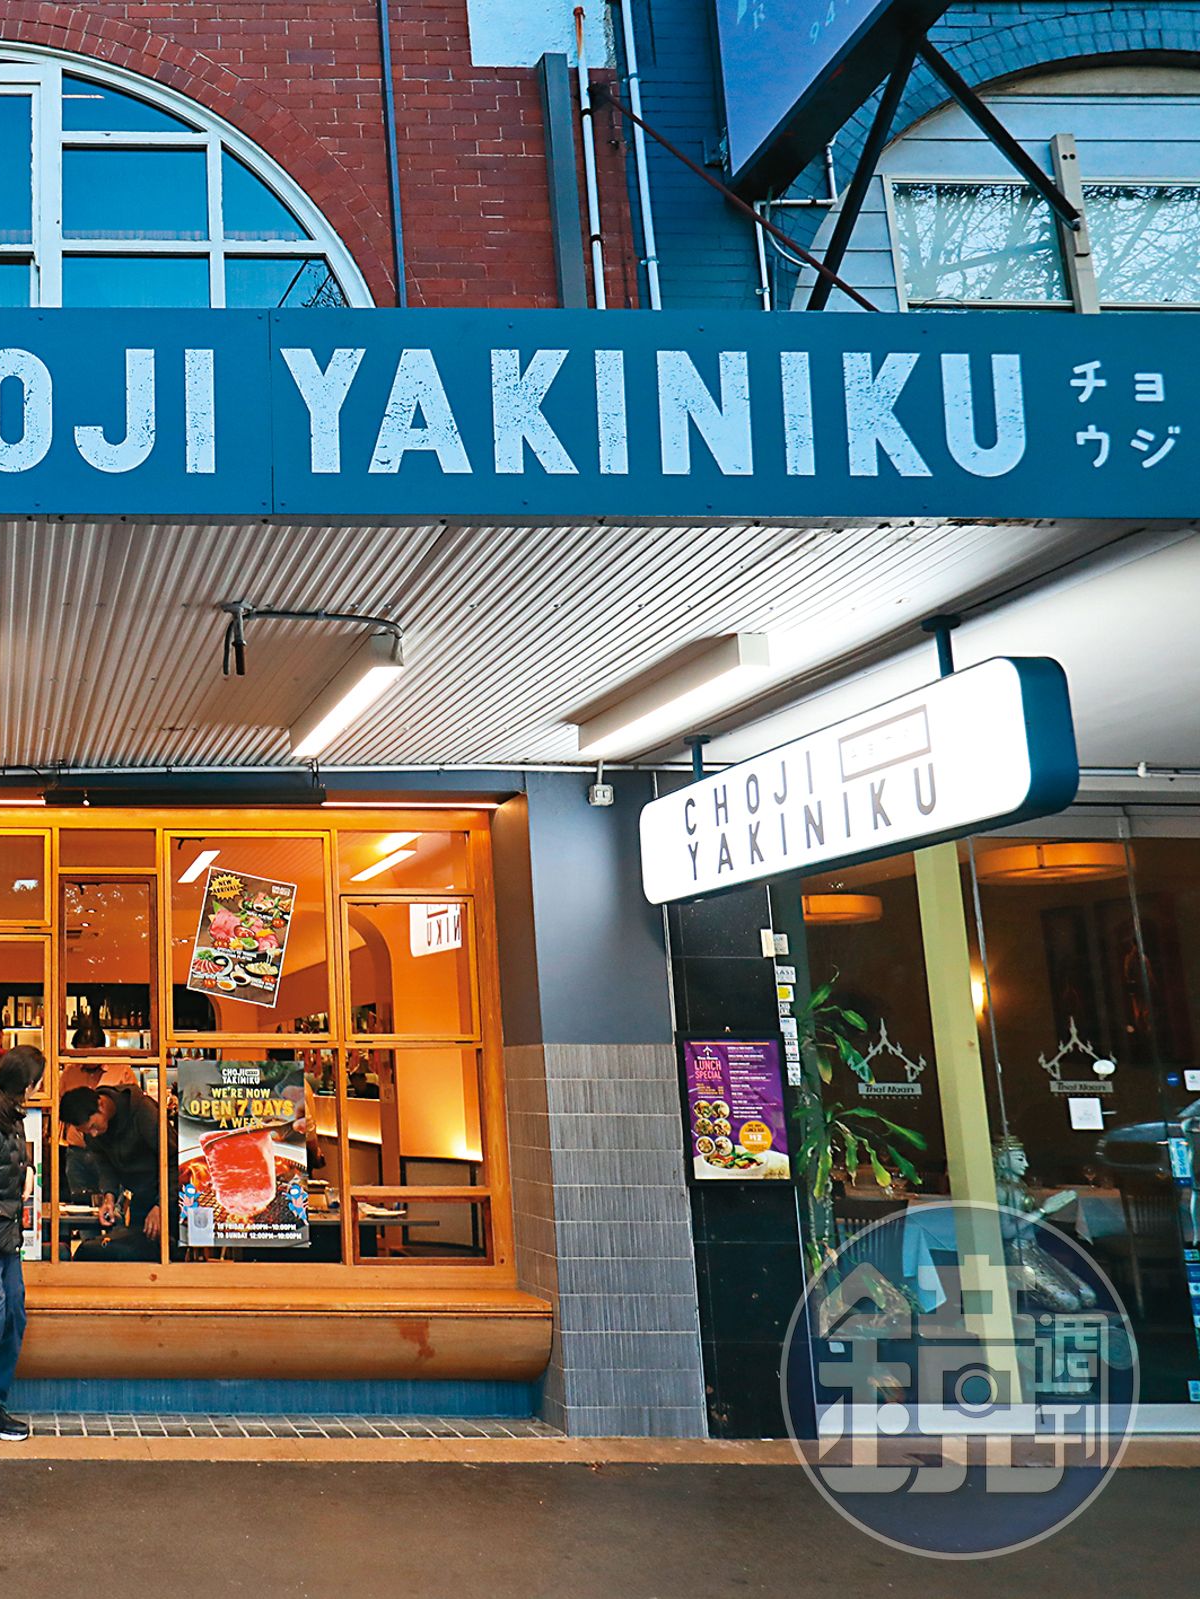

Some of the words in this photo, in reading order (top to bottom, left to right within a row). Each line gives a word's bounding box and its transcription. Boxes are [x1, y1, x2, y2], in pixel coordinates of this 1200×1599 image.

[279, 347, 1027, 478] YAKINIKU
[684, 750, 814, 836] CHOJI
[687, 762, 937, 881] YAKINIKU
[693, 1059, 723, 1071] LUNCH
[221, 1068, 246, 1077] CHOJI
[694, 1070, 723, 1080] SPECIAL
[221, 1076, 261, 1085] YAKINIKU
[211, 1087, 244, 1099] WE'RE
[245, 1088, 271, 1099] NOW
[189, 1100, 233, 1117] OPEN
[236, 1098, 249, 1117] 7
[251, 1099, 295, 1117] DAYS
[219, 1118, 228, 1129] A
[231, 1118, 264, 1129] WEEK
